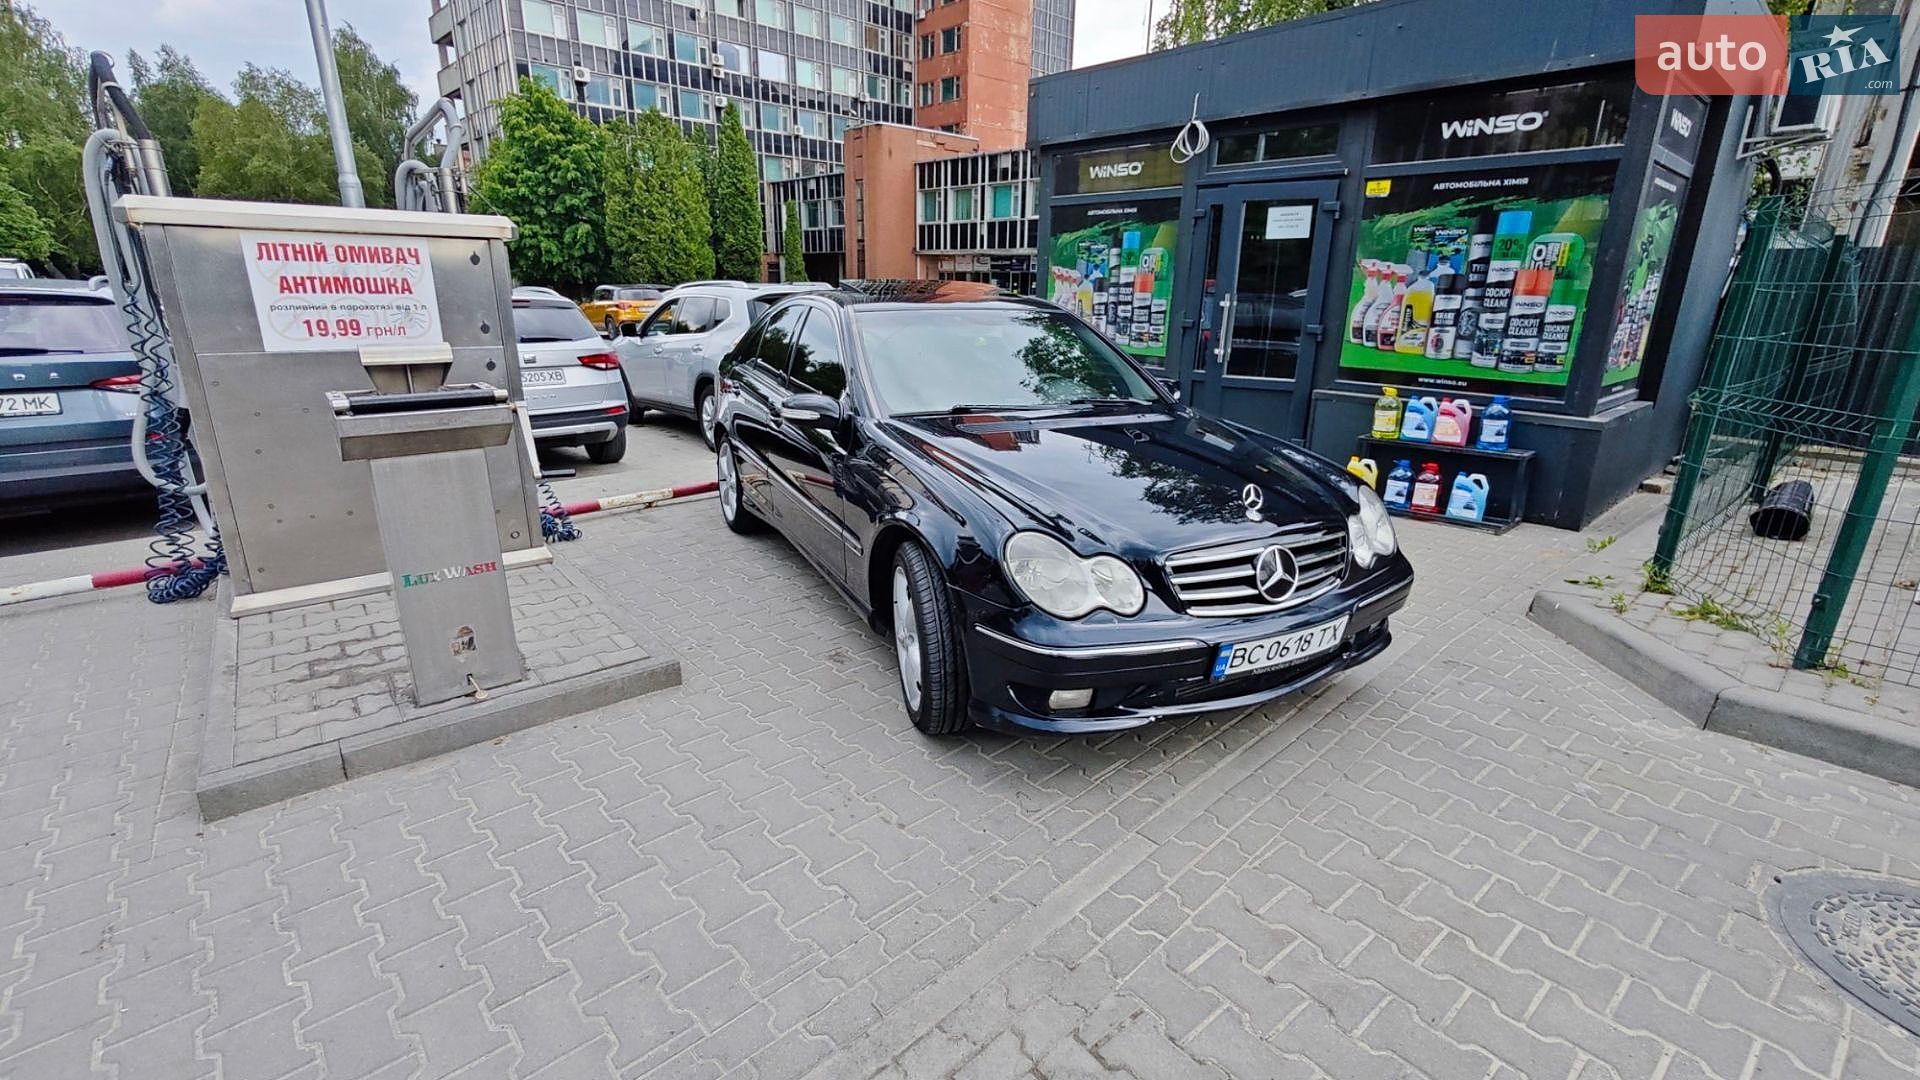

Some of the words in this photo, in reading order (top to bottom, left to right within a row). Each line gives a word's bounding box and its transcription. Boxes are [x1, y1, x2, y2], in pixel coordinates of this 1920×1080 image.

[1433, 179, 1501, 190] АВТОМОБІЛЬНА
[257, 241, 328, 262] ЛІТНІЙ
[334, 245, 421, 265] ОМИВАЧ
[279, 275, 413, 295] АНТИМОШКА
[303, 318, 362, 339] 19,99
[366, 325, 407, 339] грн/л
[22, 396, 53, 410] MK
[1229, 644, 1264, 668] BC
[1266, 632, 1314, 661] 0618
[1318, 621, 1343, 647] TX
[1215, 664, 1226, 672] UA
